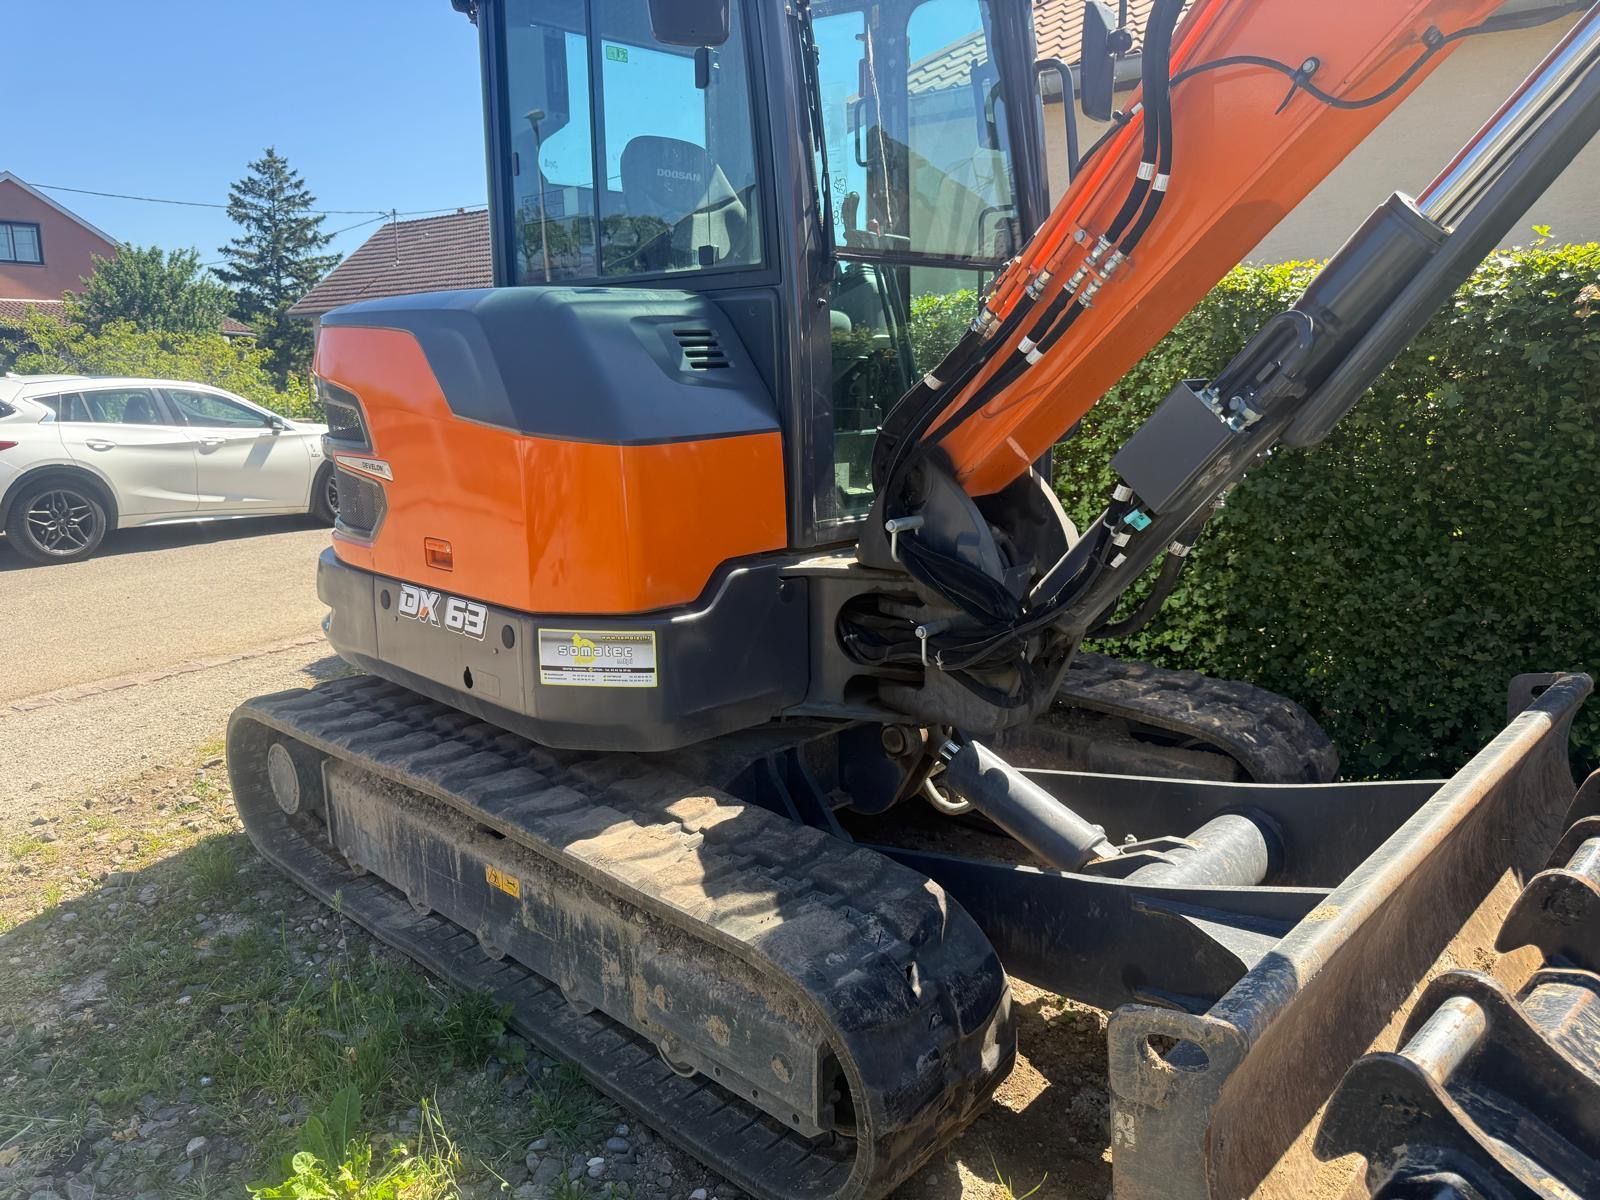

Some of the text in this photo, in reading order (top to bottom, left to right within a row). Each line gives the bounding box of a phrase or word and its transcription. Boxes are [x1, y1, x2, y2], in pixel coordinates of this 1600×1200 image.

[656, 168, 701, 182] DOOSAN
[362, 462, 383, 471] DEVELON
[399, 583, 488, 641] DX 63
[558, 645, 632, 657] somatec
